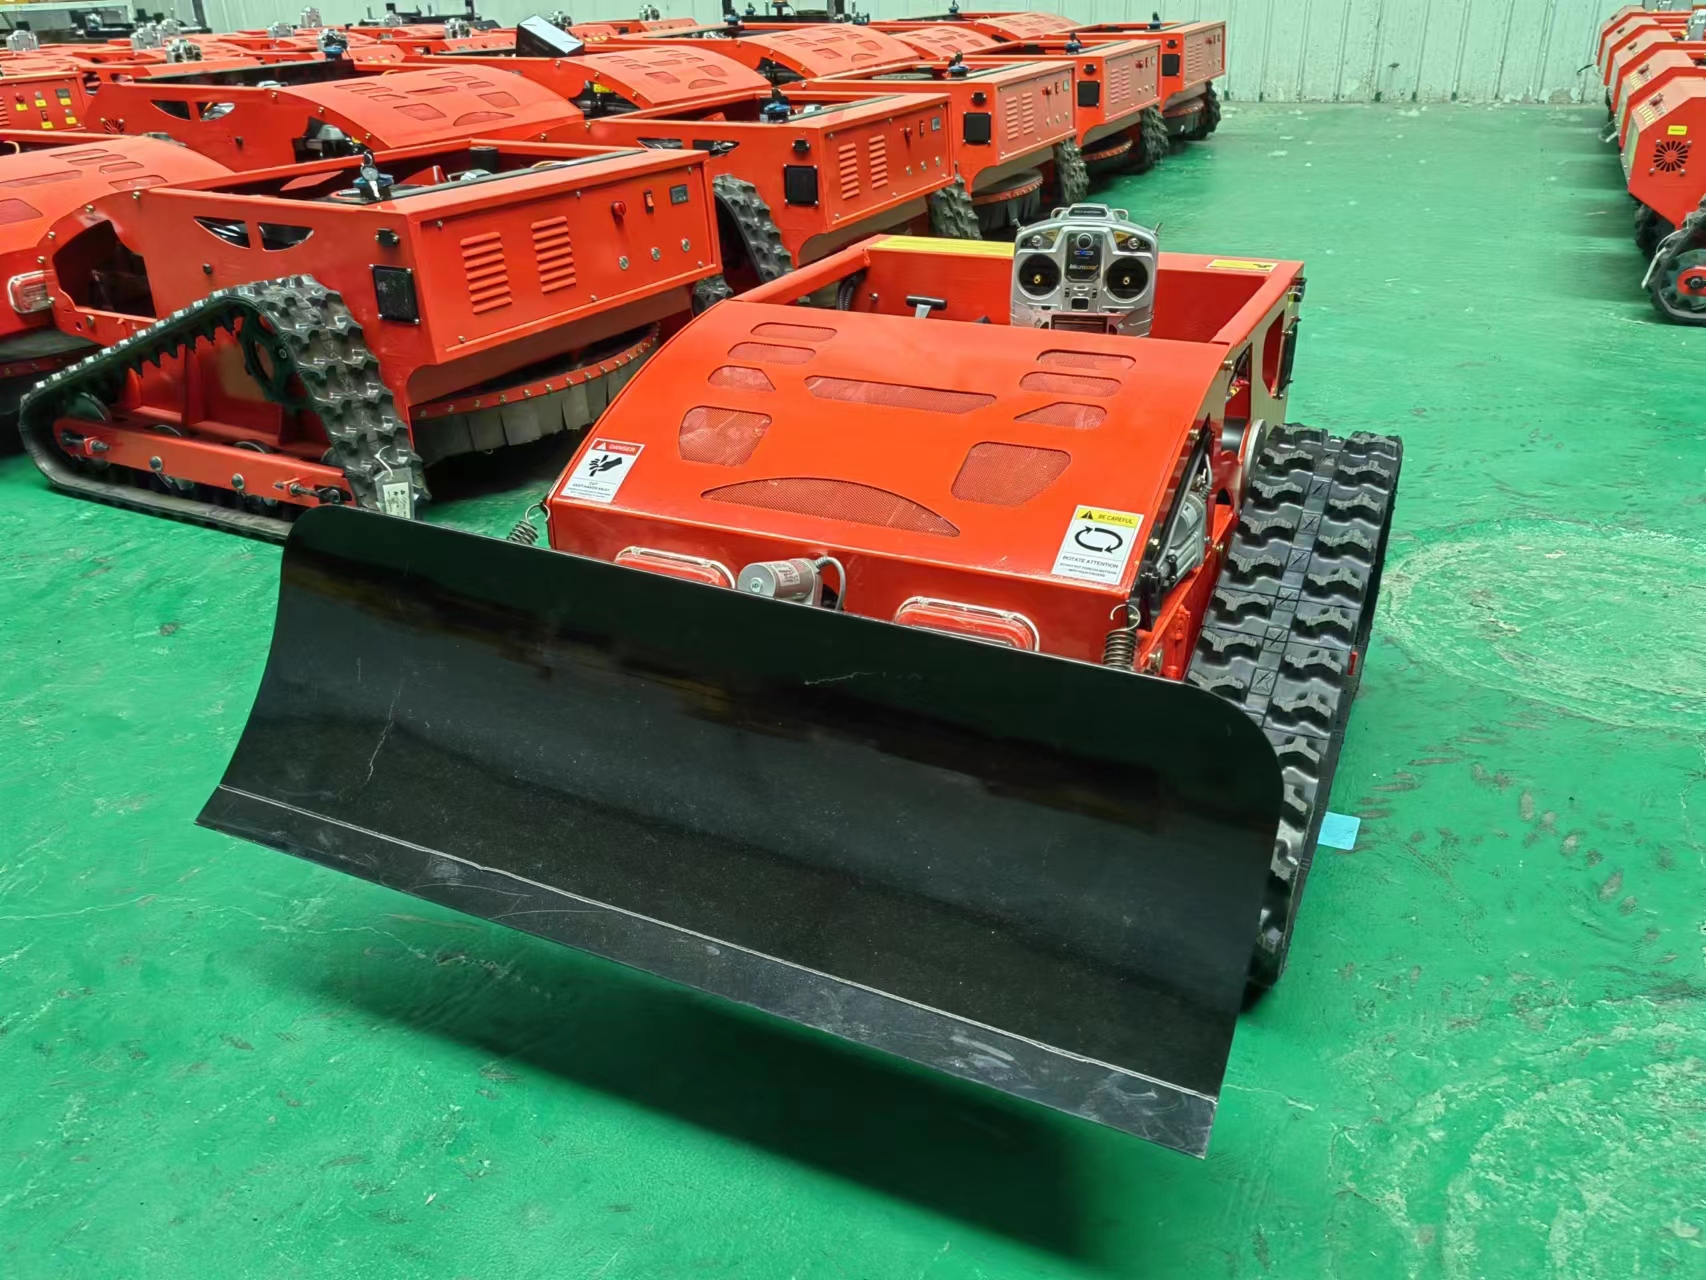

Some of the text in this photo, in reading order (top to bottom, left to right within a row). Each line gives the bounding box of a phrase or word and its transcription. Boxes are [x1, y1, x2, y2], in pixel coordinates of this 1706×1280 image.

[608, 444, 636, 453] DANGER
[1106, 514, 1133, 524] CAREFUL
[1062, 555, 1119, 569] ROTATE ATTENTION
